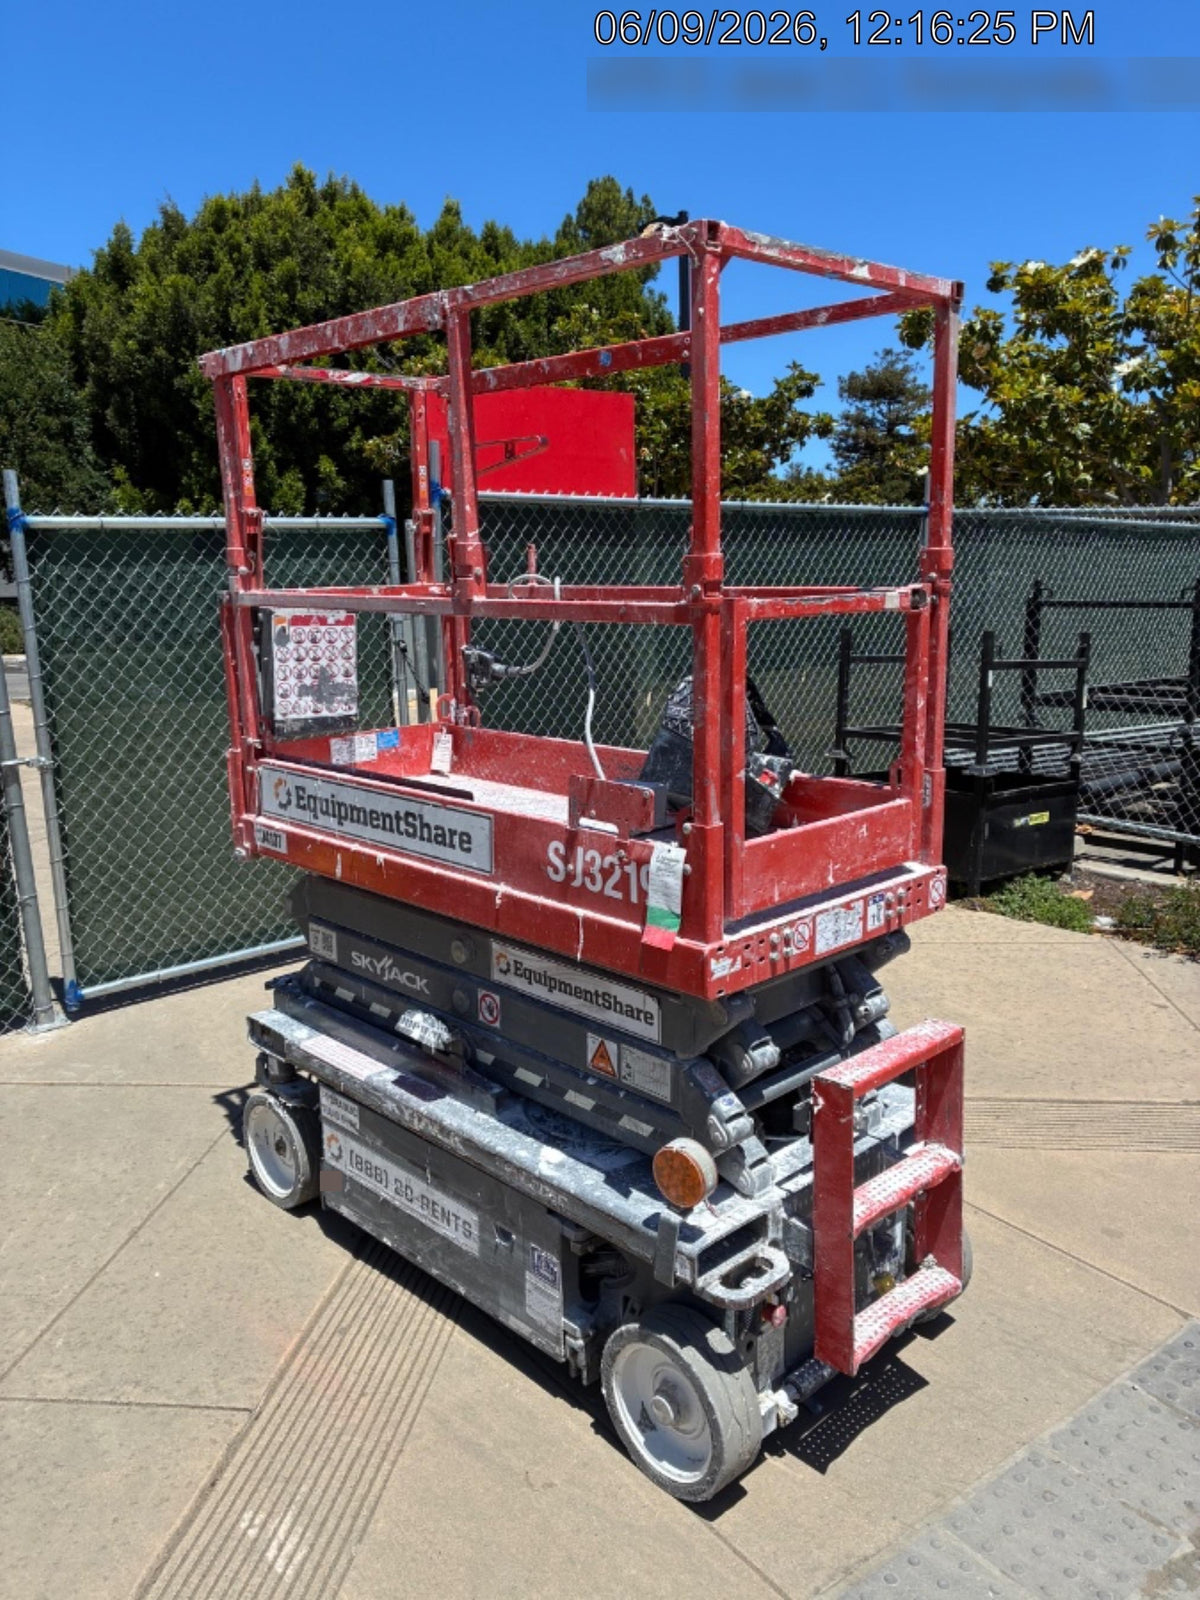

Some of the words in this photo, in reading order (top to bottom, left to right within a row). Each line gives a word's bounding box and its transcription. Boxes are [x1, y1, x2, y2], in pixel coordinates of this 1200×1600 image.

[294, 785, 473, 854] EquipmentShare
[351, 950, 431, 995] SKYJACK
[513, 959, 655, 1027] EquipmentShare
